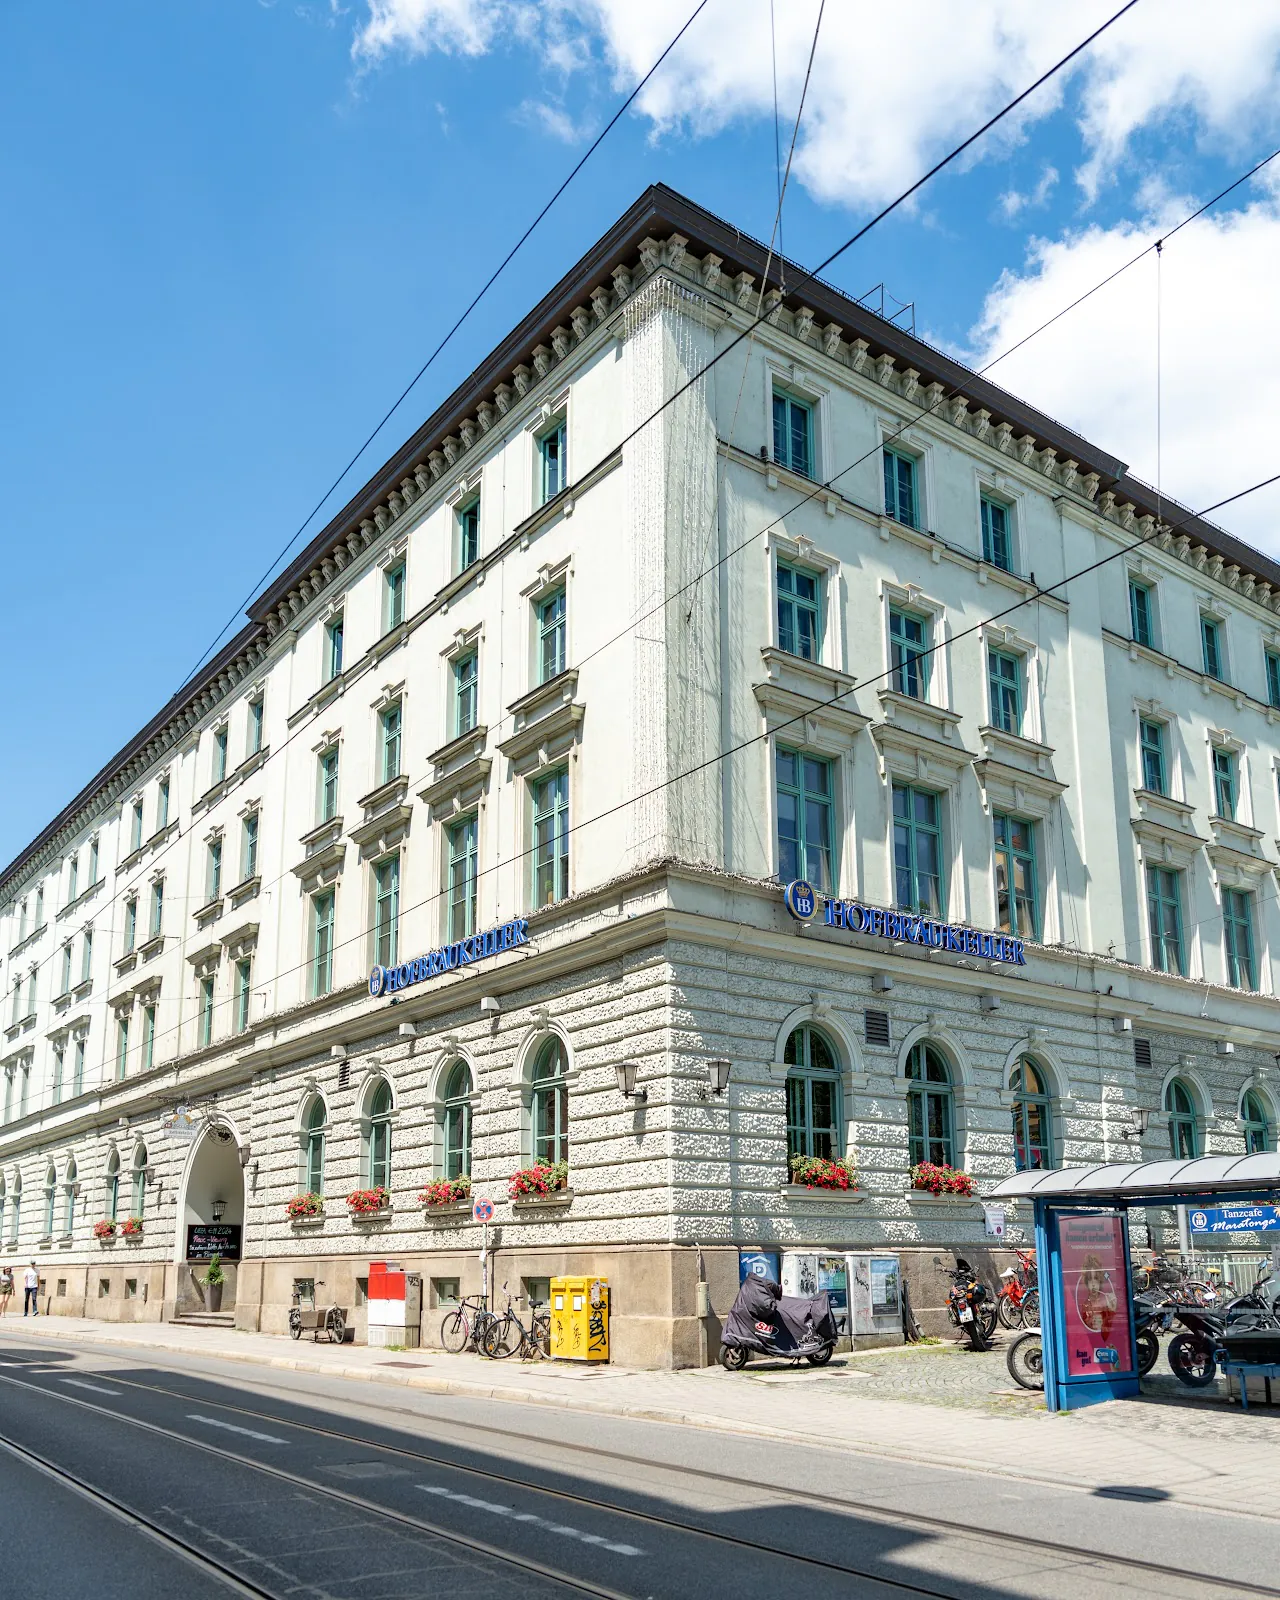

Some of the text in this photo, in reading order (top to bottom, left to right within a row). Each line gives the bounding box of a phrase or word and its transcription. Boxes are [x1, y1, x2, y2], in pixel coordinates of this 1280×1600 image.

[823, 898, 1027, 966] HOFBRÄUKELLER
[386, 919, 529, 993] HOFBRÄUKELLER
[1210, 1217, 1277, 1232] Maratonga
[1221, 1207, 1263, 1219] Tanzcafe
